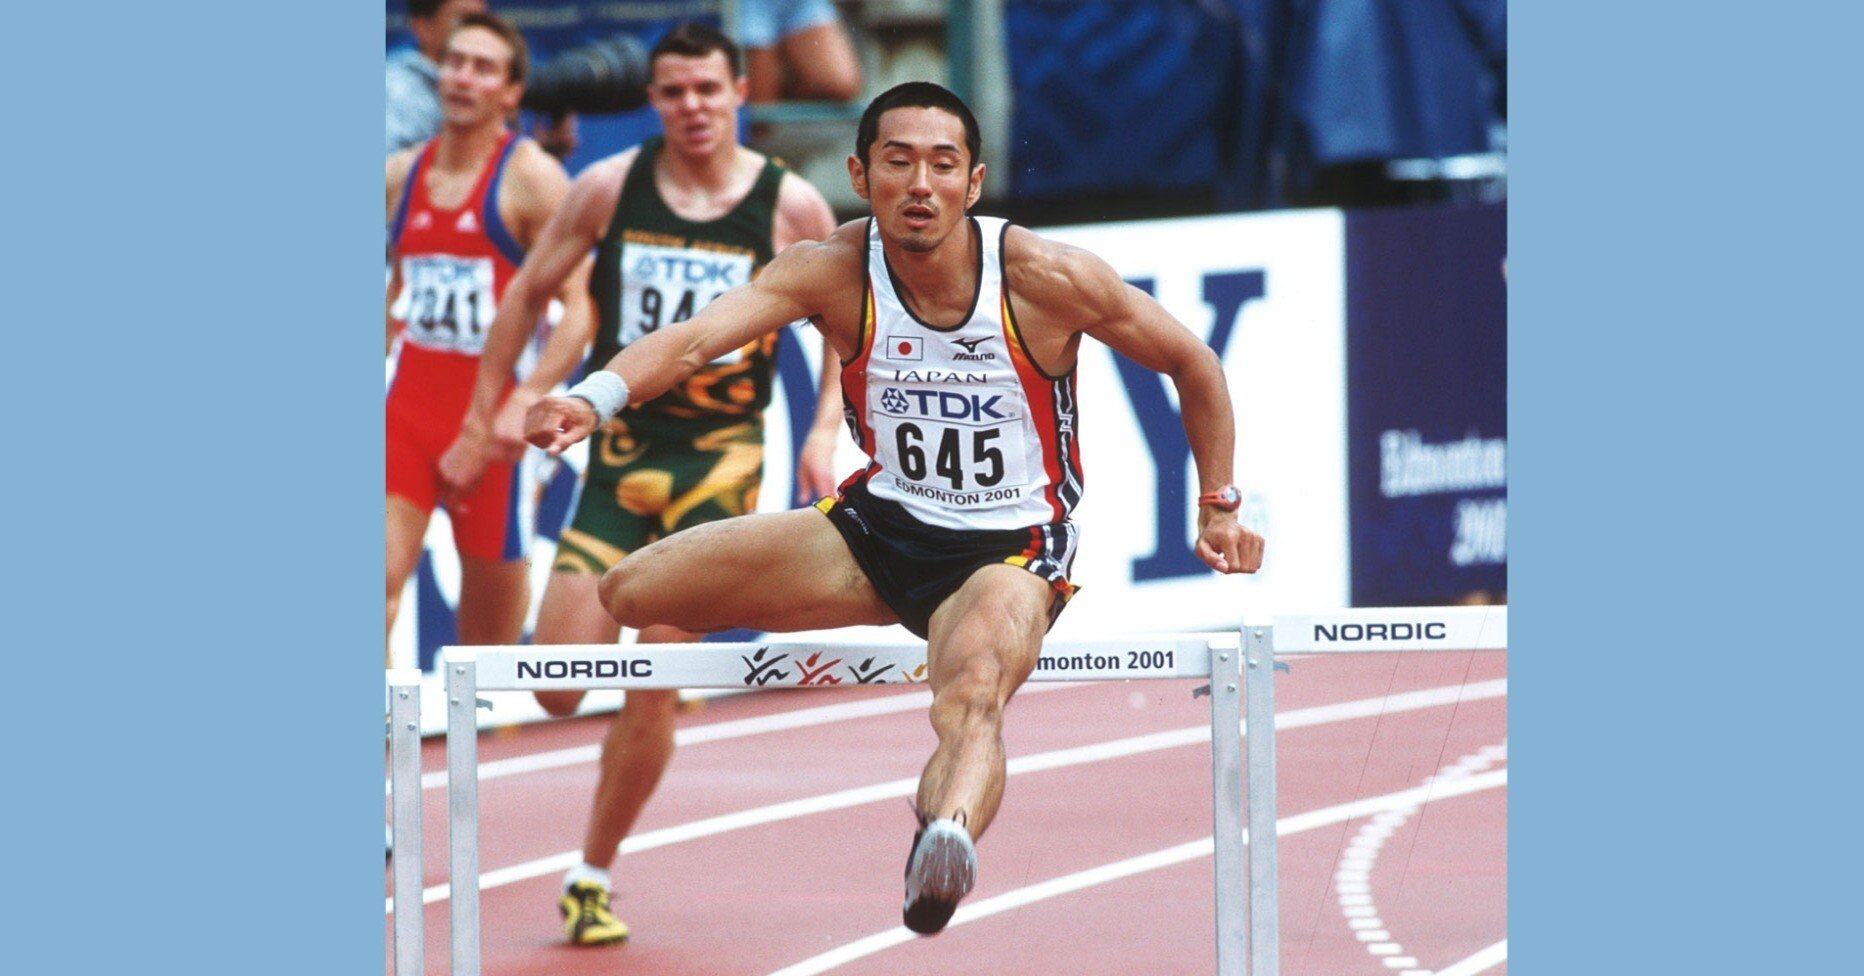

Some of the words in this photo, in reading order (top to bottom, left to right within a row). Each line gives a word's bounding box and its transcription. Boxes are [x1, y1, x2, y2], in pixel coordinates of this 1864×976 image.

[659, 256, 735, 285] TDK
[638, 285, 724, 334] 94
[905, 389, 1006, 421] TDK
[896, 422, 1004, 490] 645
[895, 478, 979, 505] EDMONTON
[984, 488, 1020, 502] 2001
[1314, 622, 1447, 642] NORDIC
[517, 659, 653, 679] NORDIC
[1037, 653, 1120, 670] monton
[1127, 650, 1174, 669] 2001
